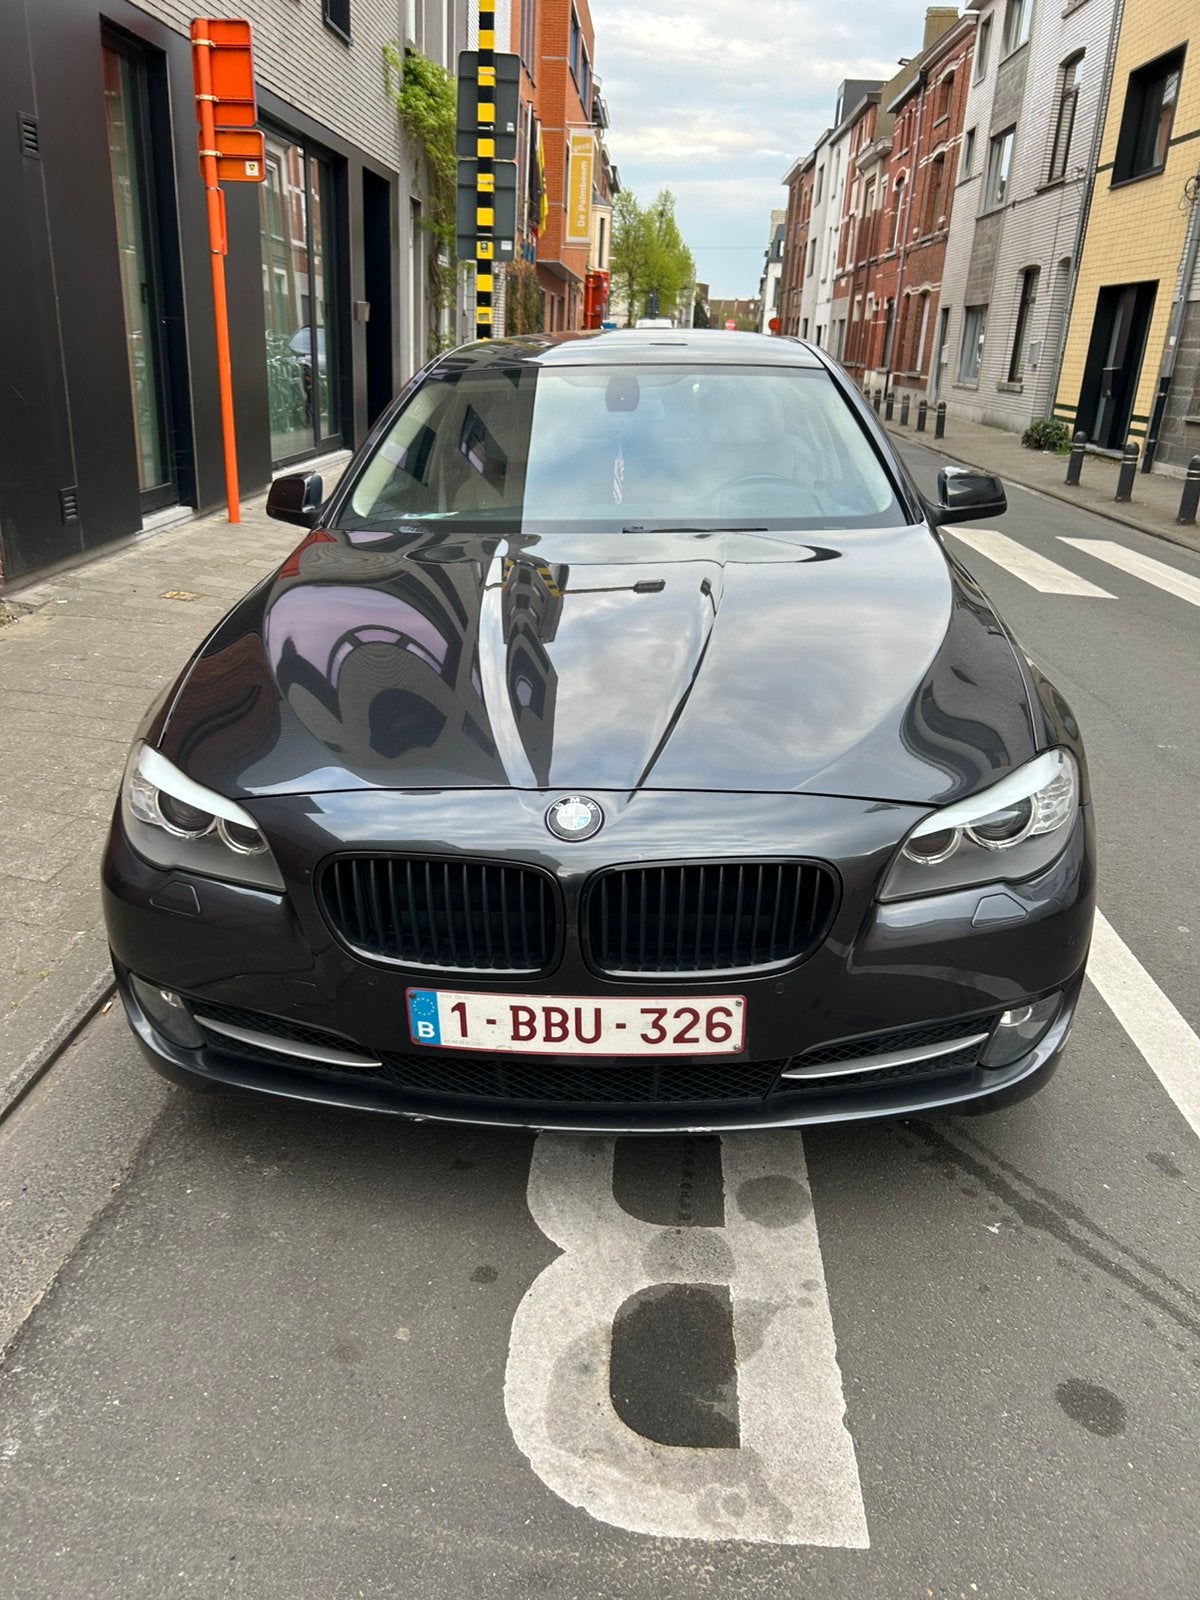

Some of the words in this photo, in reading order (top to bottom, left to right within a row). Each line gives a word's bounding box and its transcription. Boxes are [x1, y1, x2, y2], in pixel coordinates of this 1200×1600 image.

[578, 161, 587, 211] Palmboom
[577, 215, 585, 227] De
[417, 1020, 436, 1039] B
